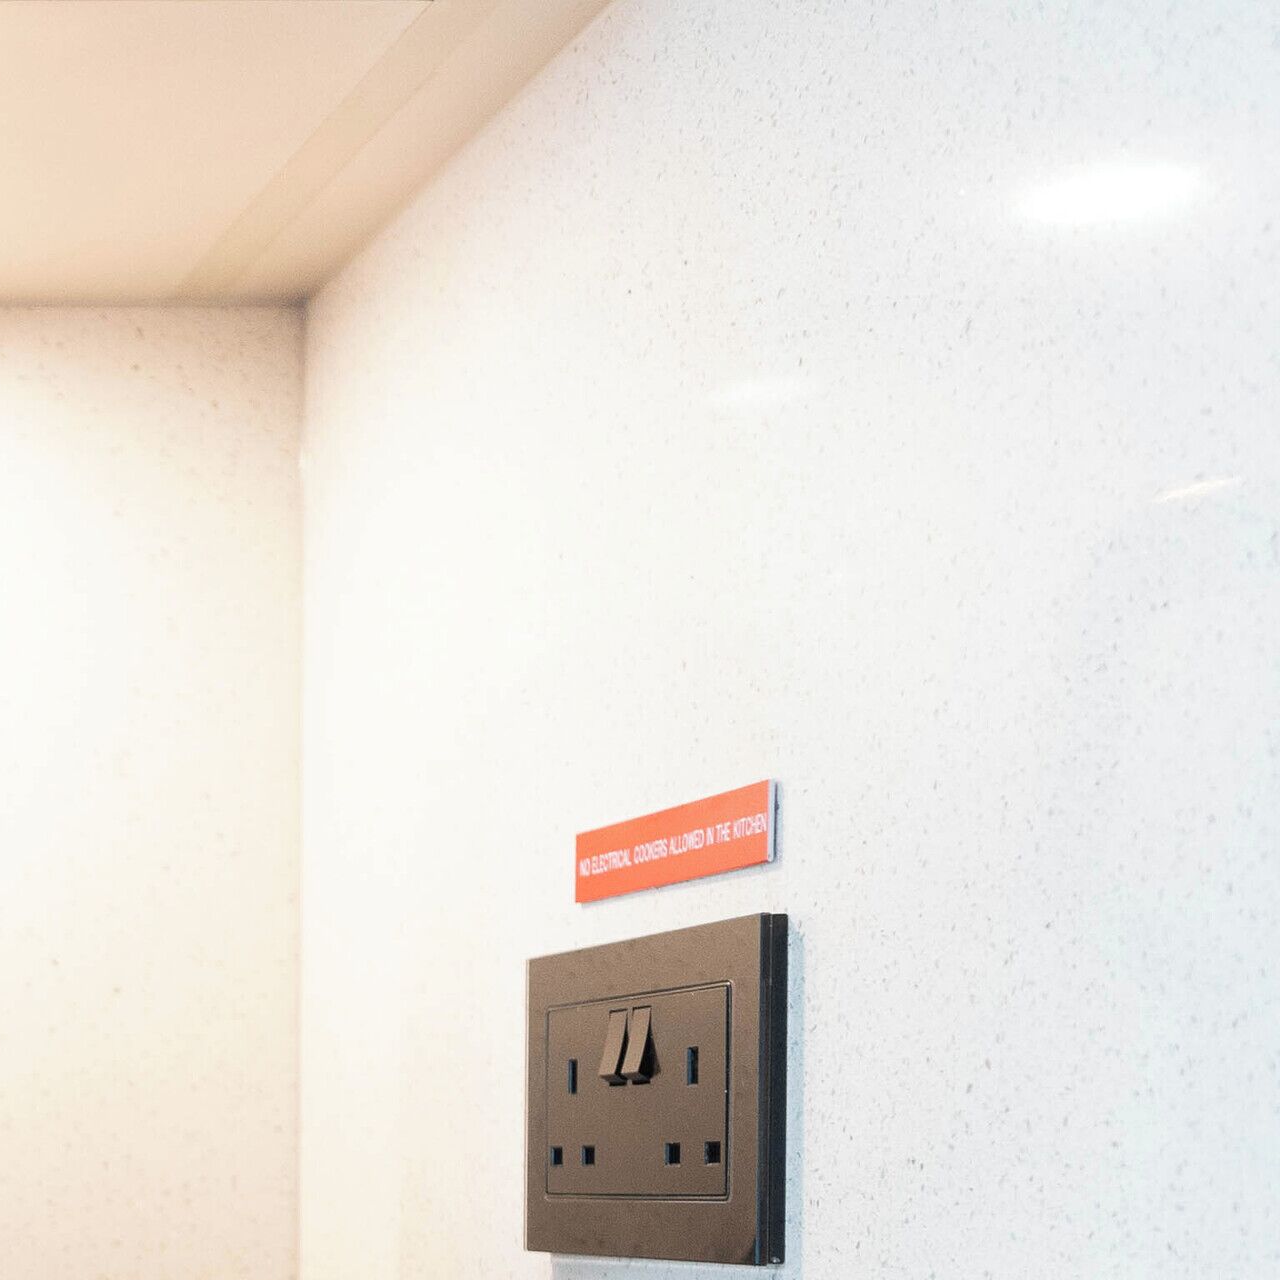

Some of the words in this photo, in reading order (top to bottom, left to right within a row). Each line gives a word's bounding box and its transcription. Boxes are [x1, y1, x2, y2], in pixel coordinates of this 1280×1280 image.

[580, 857, 590, 877] NO
[591, 849, 632, 873] ELECTRICAL
[634, 838, 668, 864] COOKERS
[669, 829, 705, 855] ALLOWED
[706, 827, 715, 846] IN
[716, 821, 731, 844] THE
[732, 812, 768, 840] KITCHEN
